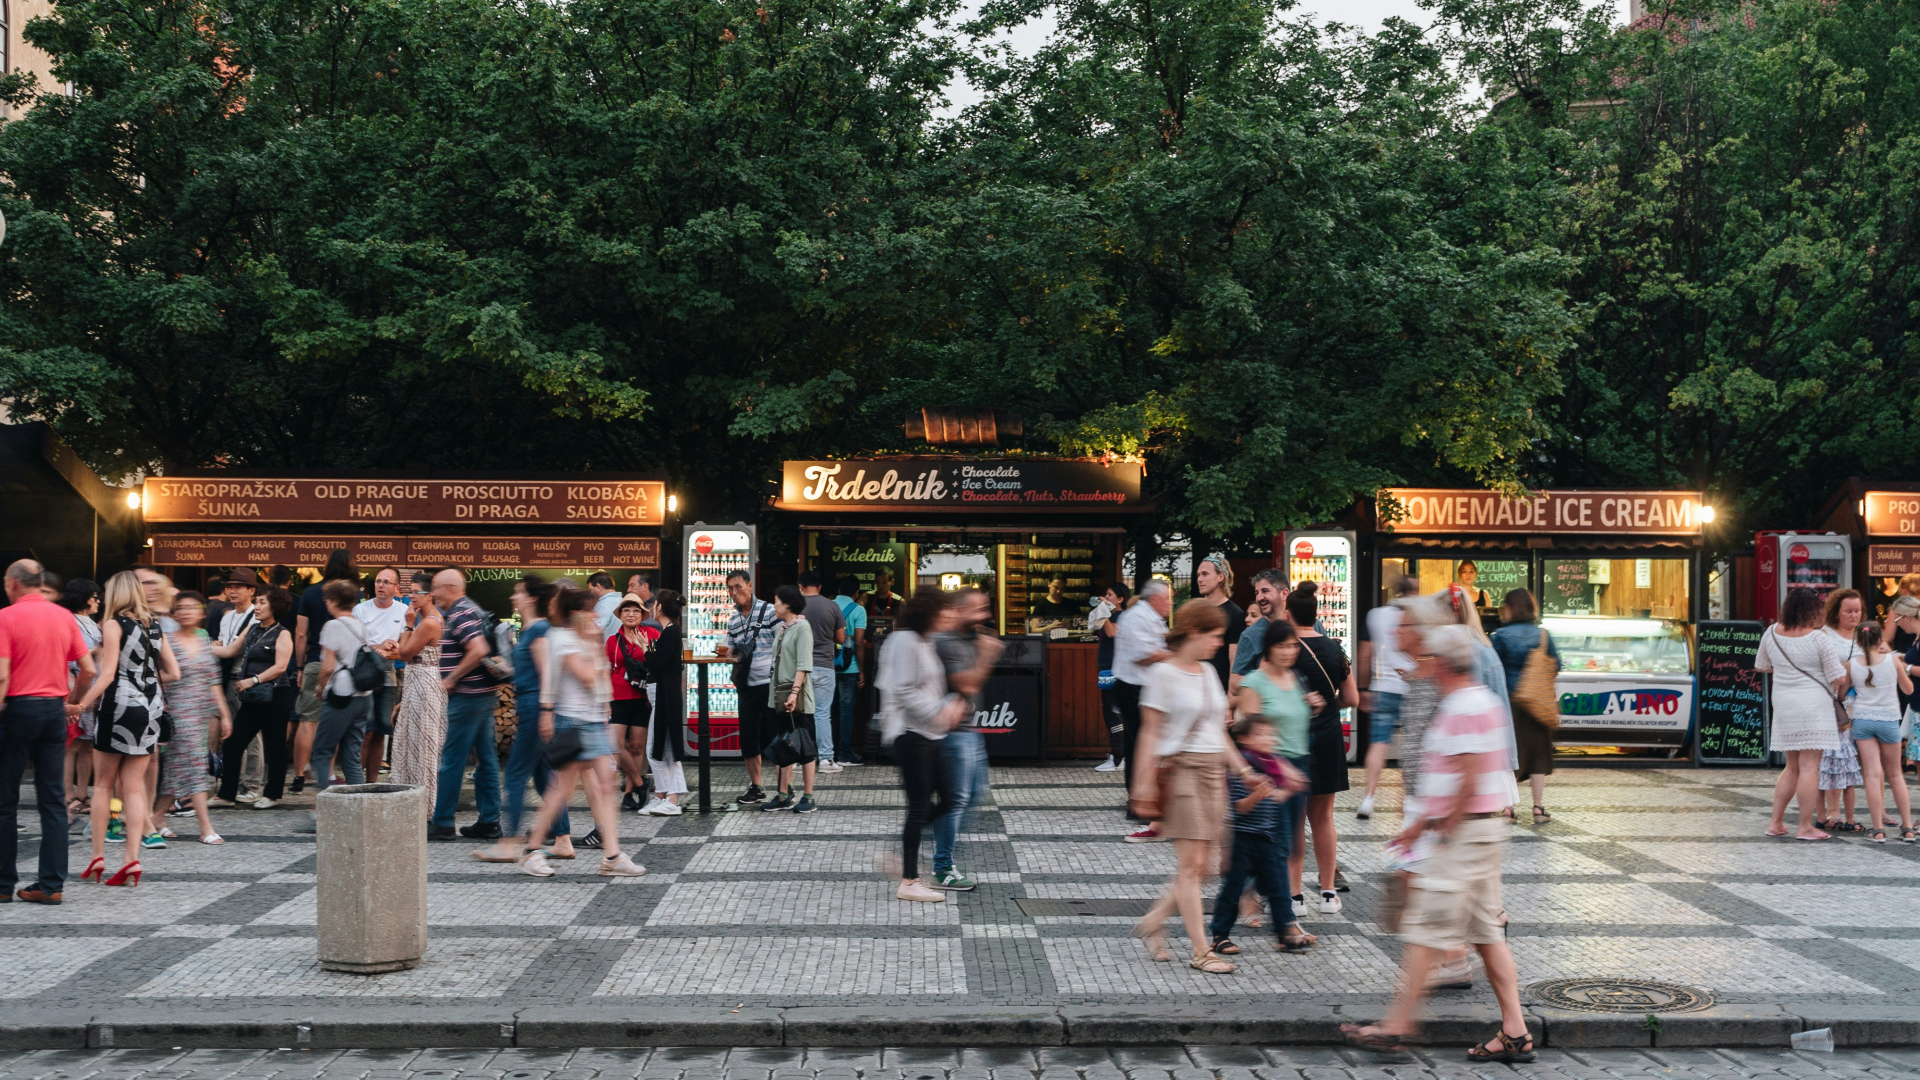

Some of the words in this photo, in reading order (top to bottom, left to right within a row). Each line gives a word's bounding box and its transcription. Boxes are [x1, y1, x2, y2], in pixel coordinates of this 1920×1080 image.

[961, 466, 1020, 478] Chocolate
[803, 463, 948, 500] Trdelník
[961, 478, 982, 490] Ice
[984, 478, 1022, 490] Cream
[160, 481, 299, 498] STAROPRAŽSKÁ
[314, 485, 351, 499] OLD
[356, 485, 429, 499] PRAGUE
[442, 485, 553, 500] PROSCIUTTO
[567, 484, 648, 501] KLOBÁSA
[961, 490, 1022, 503] Chocolate,
[1023, 490, 1058, 503] Nuts,
[1059, 490, 1126, 504] Strawberry
[198, 499, 261, 516] ŠUNKA
[349, 503, 393, 517] HAM
[455, 505, 473, 518] DI
[478, 505, 540, 518] PRAGA
[566, 505, 648, 519] SAUSAGE
[1888, 500, 1920, 515] PRO
[1555, 498, 1593, 527] ICE
[1600, 498, 1691, 528] CREAM
[1900, 519, 1916, 533] DI
[158, 539, 223, 548] STAROPRAŽSKÁ
[232, 540, 250, 549] OLD
[251, 540, 287, 549] PRAGUE
[294, 541, 347, 549] PROSCIUTTO
[359, 541, 393, 550] PRAGER
[412, 541, 454, 550] СВИНИНА
[456, 542, 470, 550] ПО
[482, 541, 521, 551] KLOBÁSA
[533, 541, 571, 551] HALUŠKY
[583, 543, 605, 551] PIVO
[617, 541, 651, 551] SVAŘÁK
[175, 551, 206, 561] ŠUNKA
[248, 553, 270, 561] HAM
[300, 554, 309, 562] DI
[311, 554, 328, 562] PRA
[356, 554, 398, 562] SCHINKEN
[407, 554, 474, 563] СТАРОПРАЖСКИ
[482, 555, 520, 563] SAUSAGE
[583, 555, 605, 564] BEER
[613, 555, 631, 564] HOT
[632, 555, 655, 564] WINE
[832, 546, 896, 563] Trdelník
[1877, 551, 1903, 560] SVAŘÁK
[1873, 564, 1888, 572] HOT
[1888, 564, 1907, 572] WINE
[465, 568, 523, 583] SAUSAGE
[1488, 573, 1518, 584] CREAM
[1560, 692, 1679, 715] GELATINO
